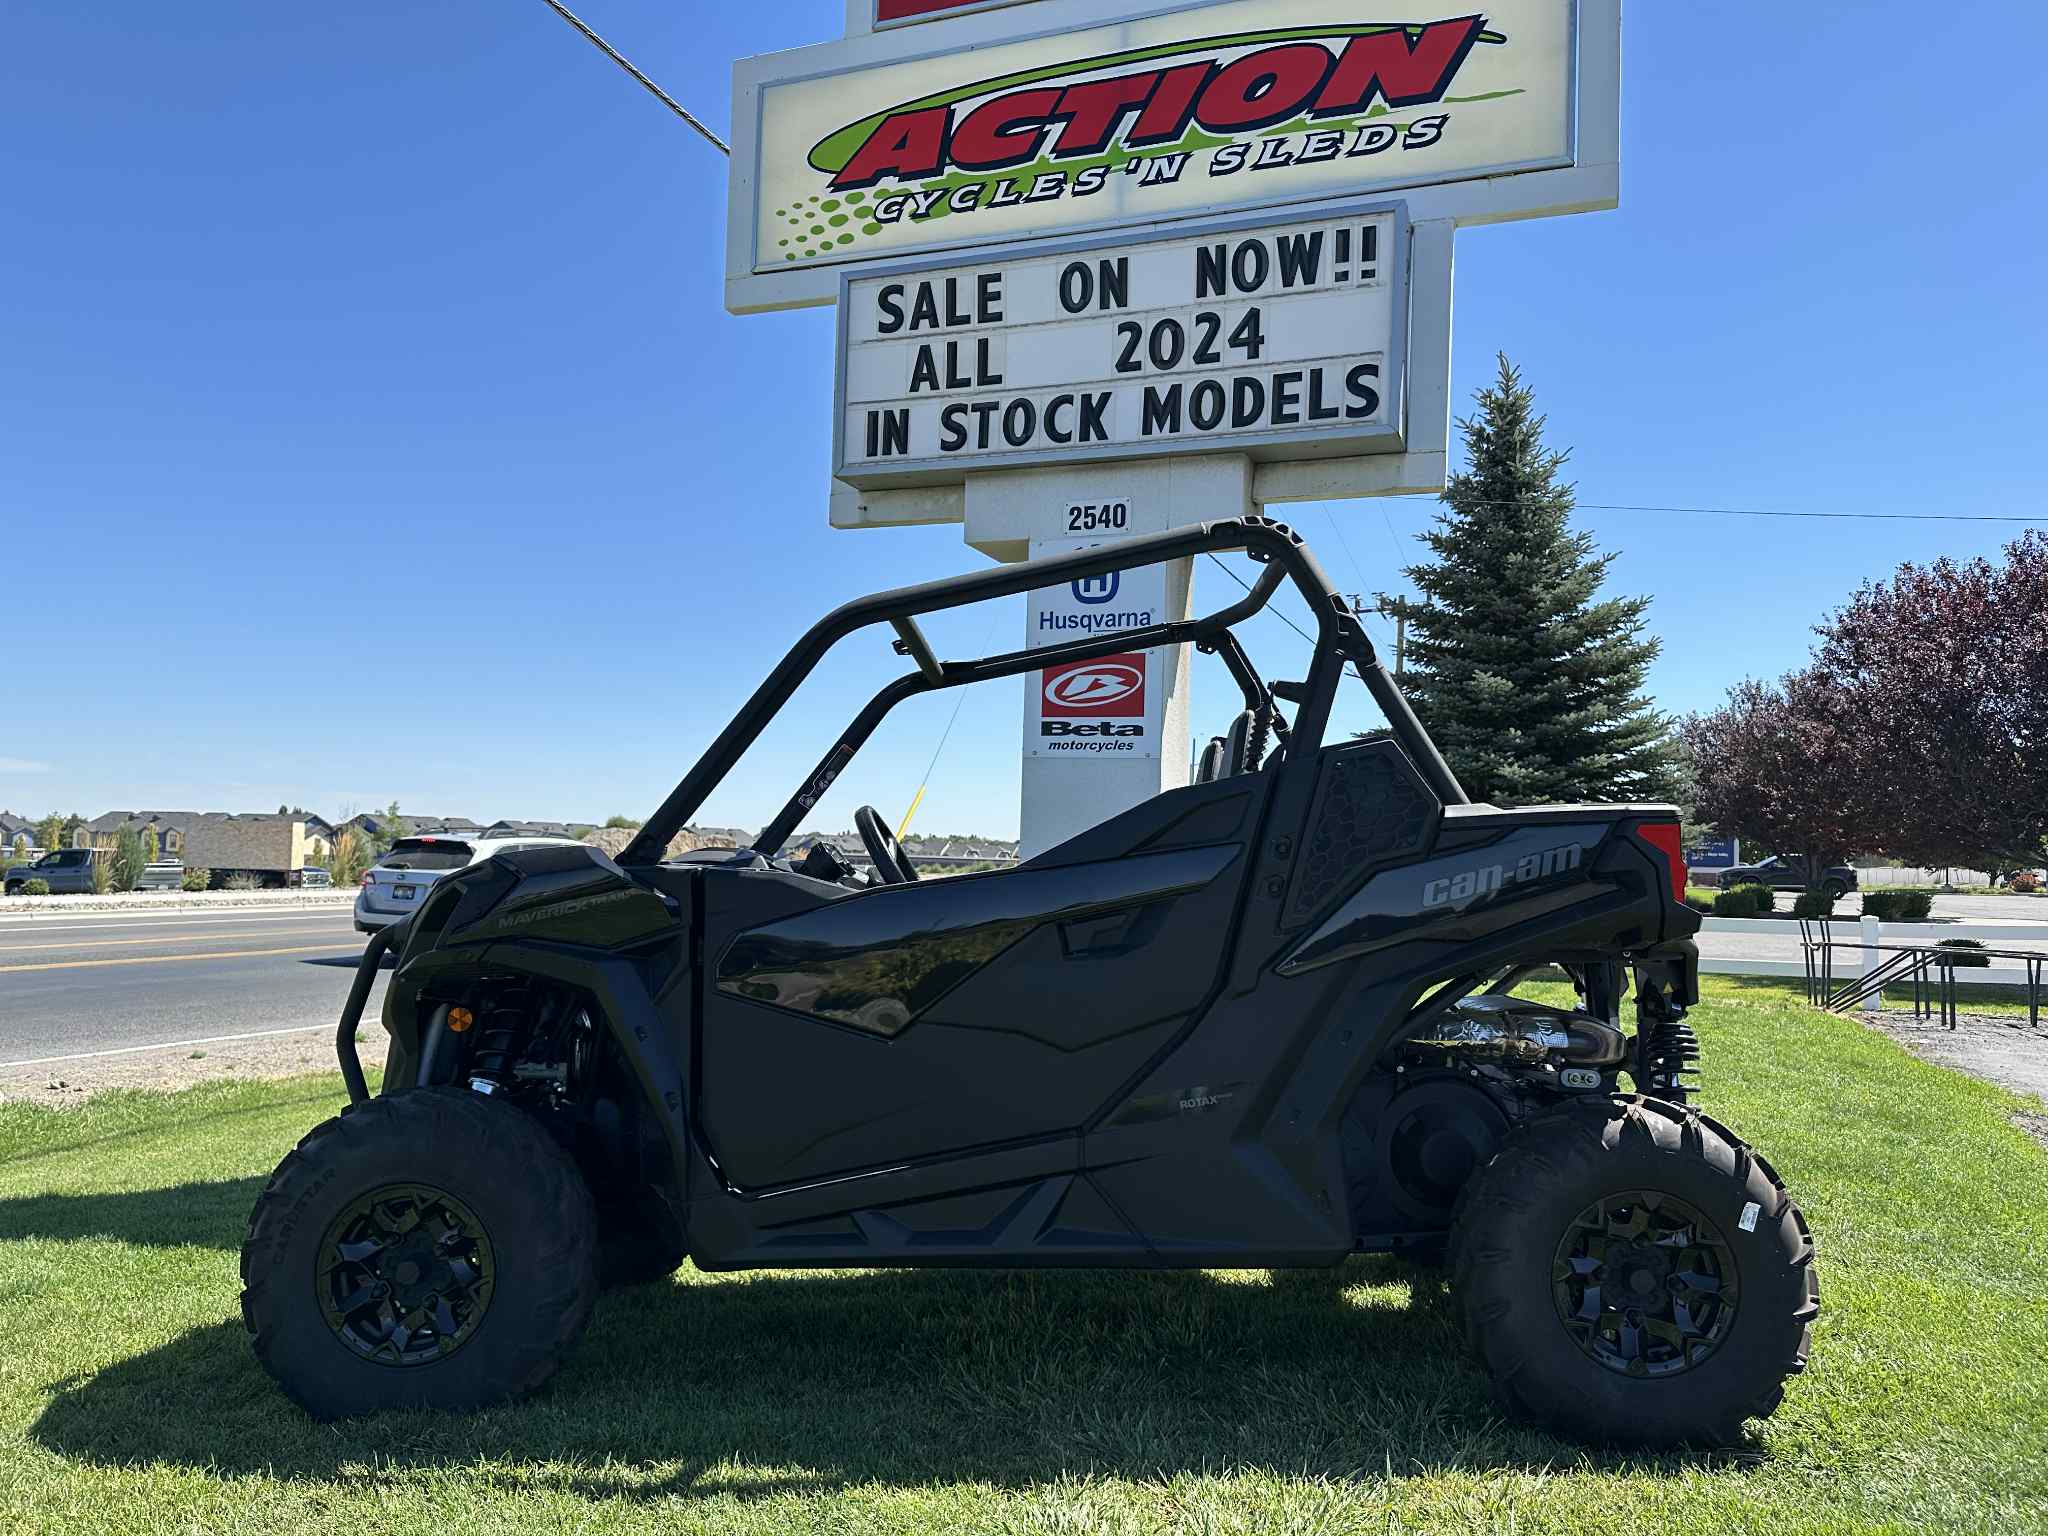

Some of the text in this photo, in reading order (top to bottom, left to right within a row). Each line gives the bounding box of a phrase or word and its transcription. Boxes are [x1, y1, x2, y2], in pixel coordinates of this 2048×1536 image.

[828, 14, 1486, 192] ACTION
[872, 114, 1450, 225] CYCLES 'N SLEDS
[877, 224, 1378, 335] SALE ON NOW!!
[909, 307, 1265, 393] ALL 2024
[866, 363, 1381, 458] IN STOCK MODELS
[1068, 503, 1127, 531] 2540
[1039, 610, 1152, 633] Husqvarna
[1041, 721, 1144, 737] Beta
[1048, 740, 1134, 753] motorcycles
[1422, 839, 1584, 911] can-am
[497, 900, 590, 929] MAVERICK
[1179, 1095, 1218, 1110] ROTAX
